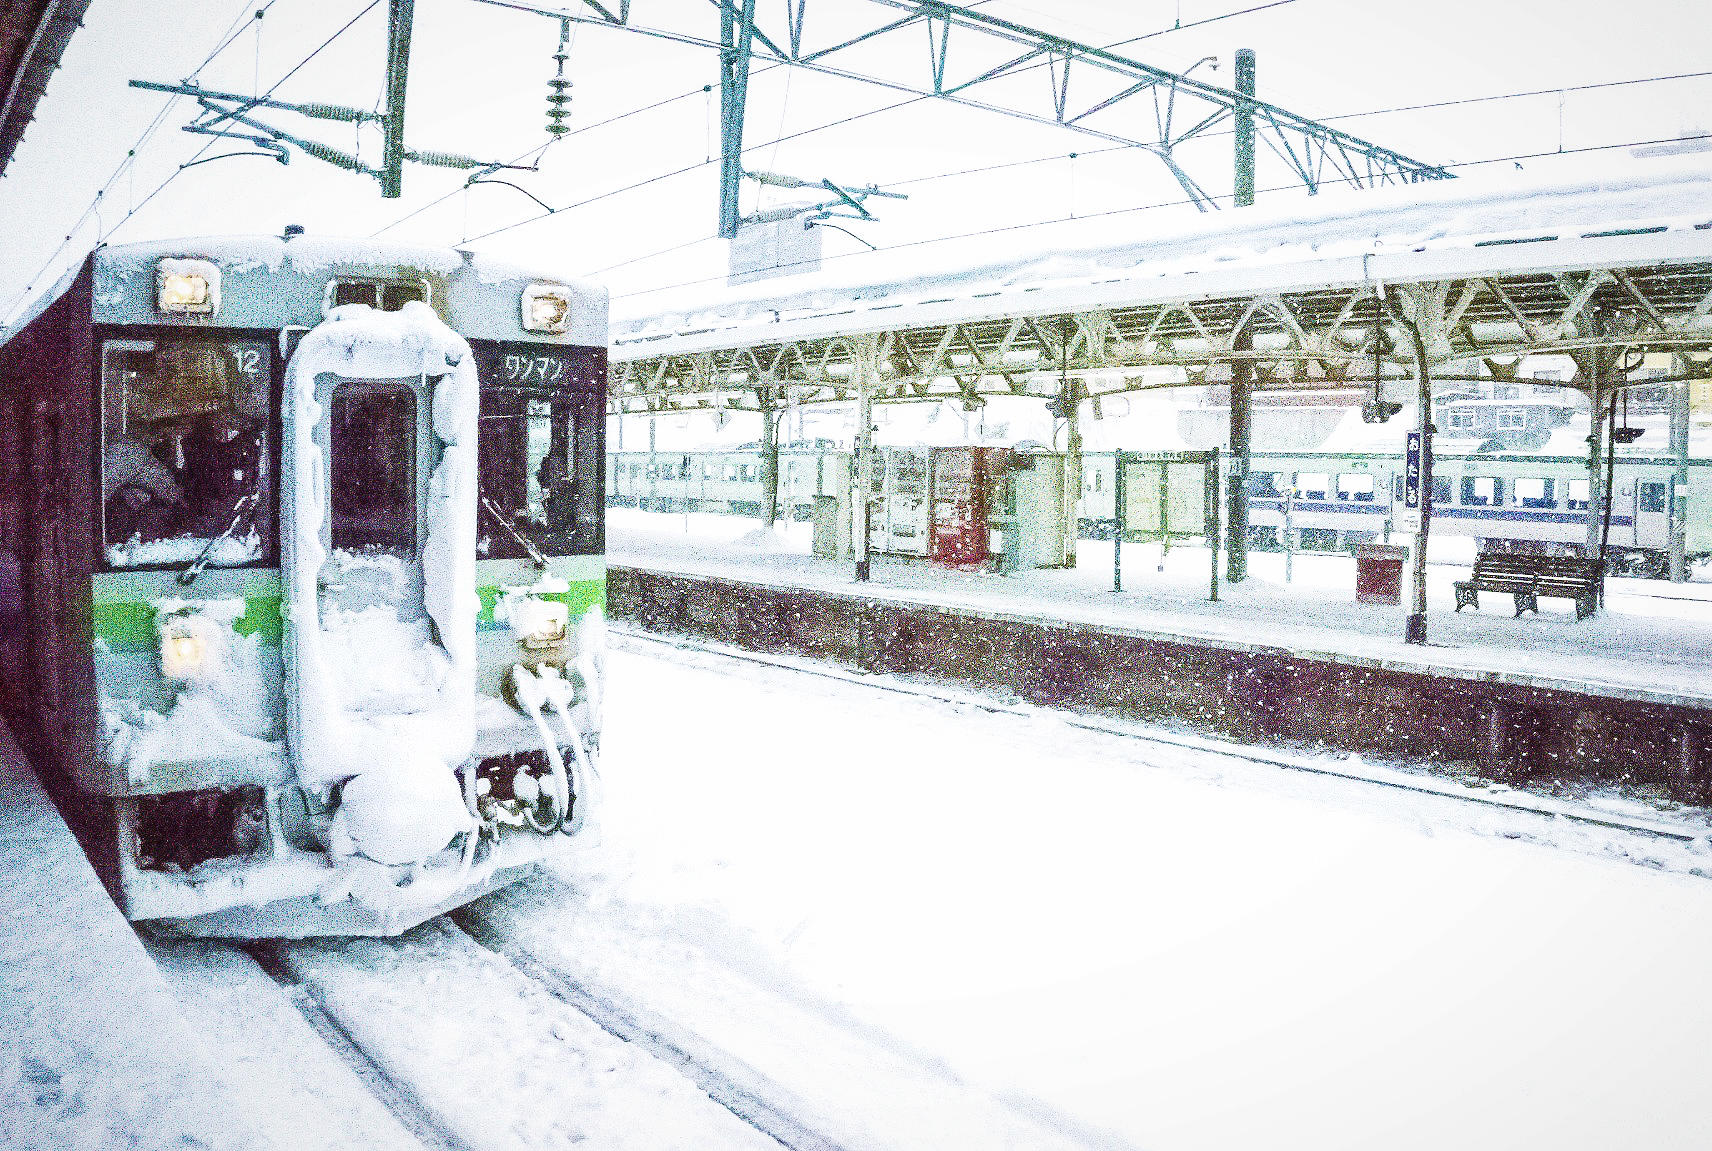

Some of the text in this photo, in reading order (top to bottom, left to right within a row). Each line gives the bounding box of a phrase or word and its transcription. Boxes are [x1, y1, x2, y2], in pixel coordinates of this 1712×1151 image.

[232, 349, 260, 373] 12
[506, 355, 563, 380] ワンマン
[1407, 437, 1420, 504] おたる
